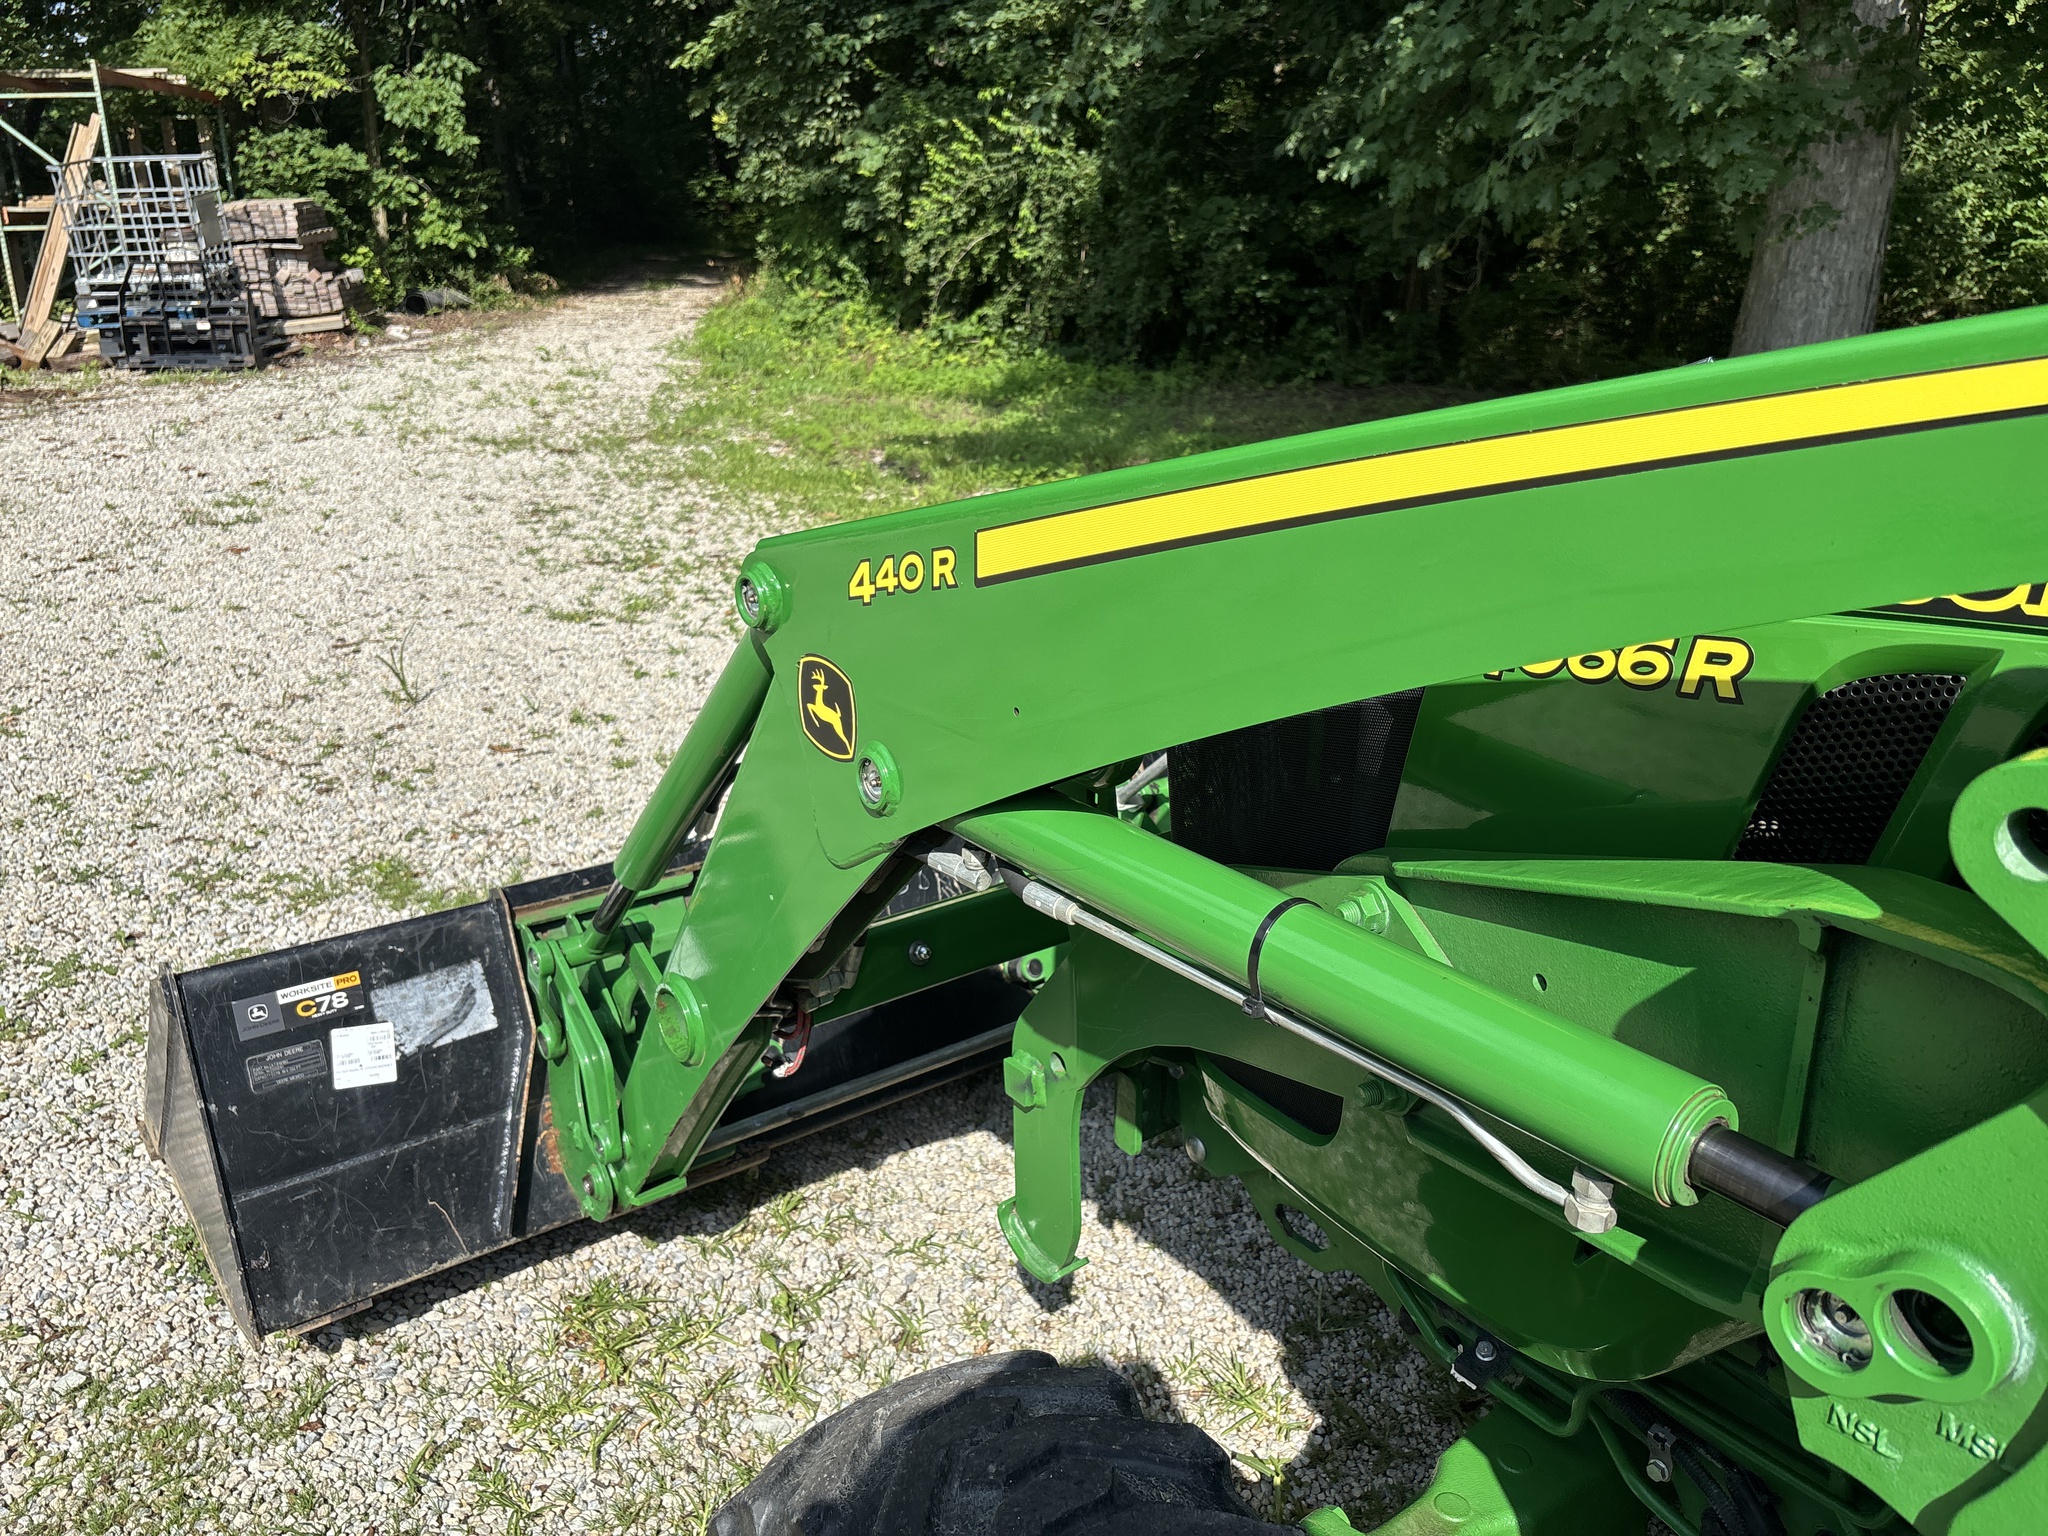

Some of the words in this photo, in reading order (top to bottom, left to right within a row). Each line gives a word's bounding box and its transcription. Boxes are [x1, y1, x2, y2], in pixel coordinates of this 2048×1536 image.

[280, 981, 333, 999] WORKSITE
[336, 975, 357, 986] PRO
[296, 991, 349, 1017] C78
[325, 1008, 338, 1016] DUTY
[265, 1051, 283, 1062] JOHN
[283, 1046, 304, 1057] DEERE
[1826, 1401, 1903, 1461] NSL
[1935, 1411, 2007, 1461] MS
